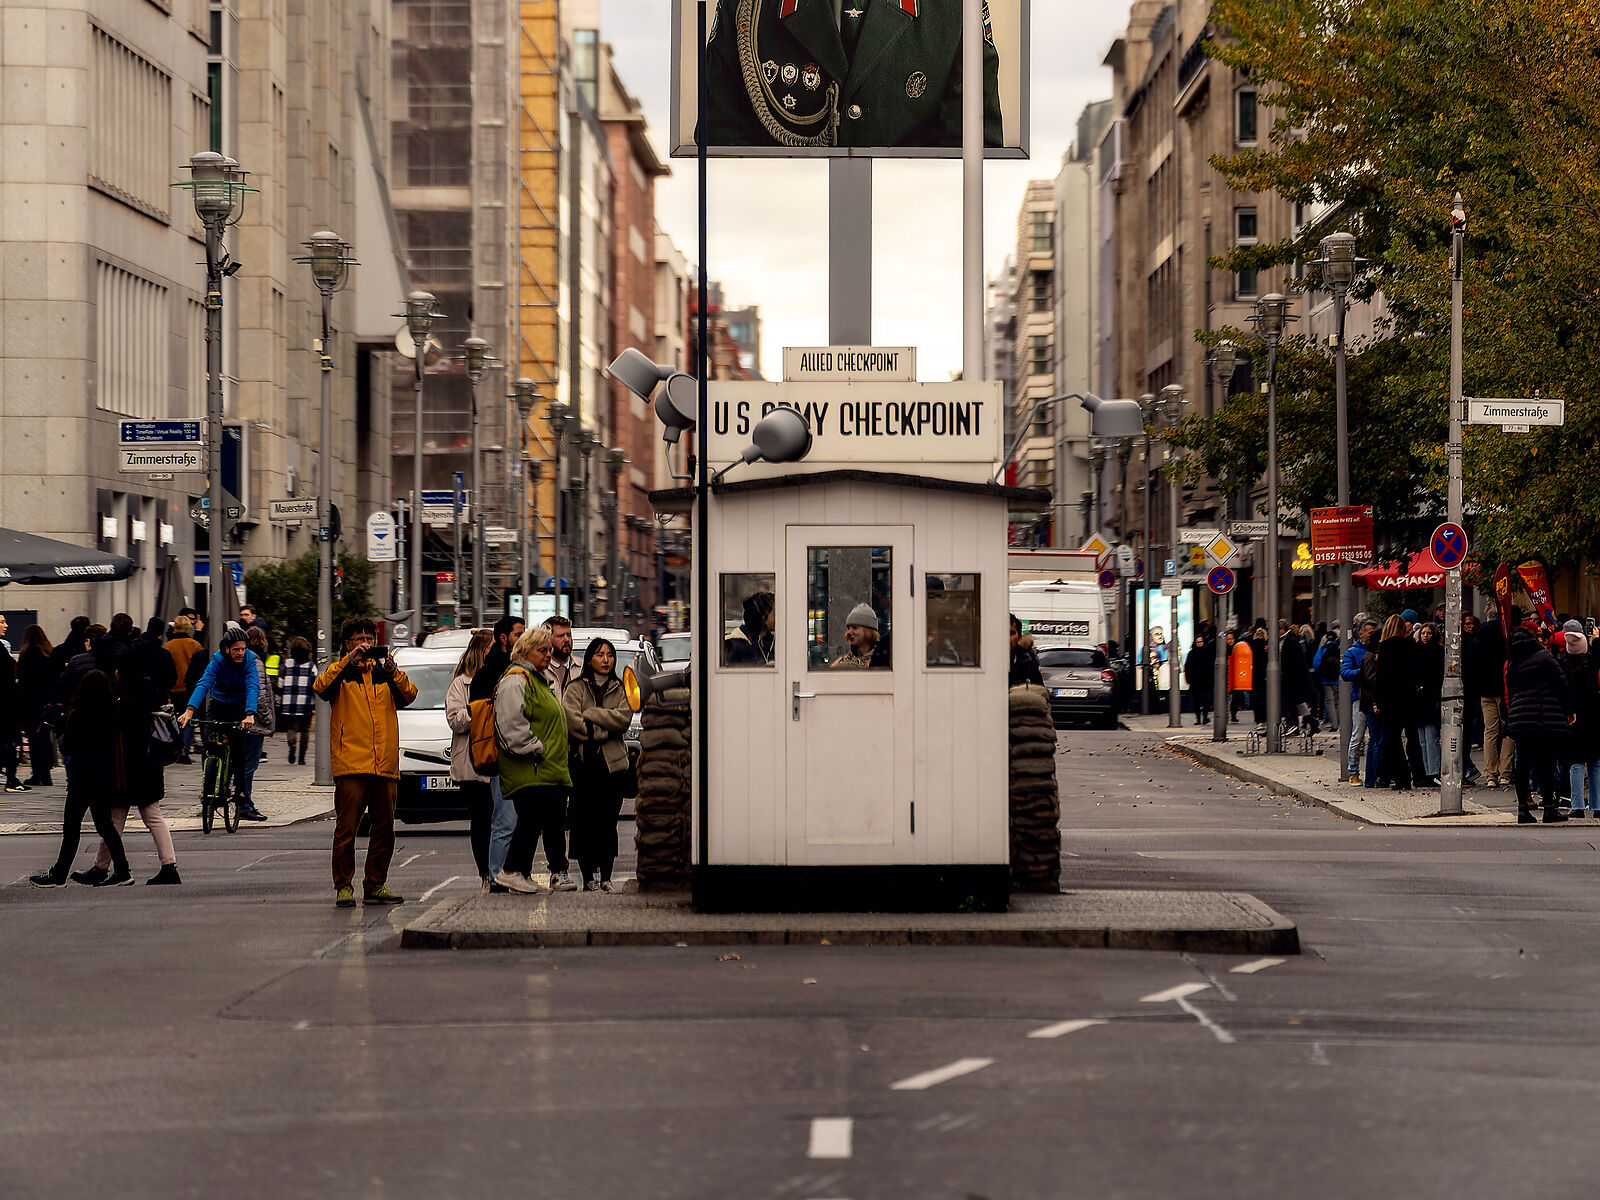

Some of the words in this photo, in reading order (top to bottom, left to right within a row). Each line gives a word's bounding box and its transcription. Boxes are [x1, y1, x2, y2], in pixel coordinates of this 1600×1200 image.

[800, 353, 832, 372] ALLIED
[837, 353, 899, 372] CHECKPOINT
[714, 401, 729, 435] U
[736, 401, 751, 435] S
[839, 401, 984, 436] CHECKPOINT
[1483, 405, 1549, 420] Zimmerstraße
[127, 452, 197, 467] Zimmerstraße
[275, 503, 313, 515] Mauerstraße
[1315, 552, 1336, 561] 0152
[1377, 574, 1440, 588] VAPIANO
[1022, 622, 1089, 634] enterprise
